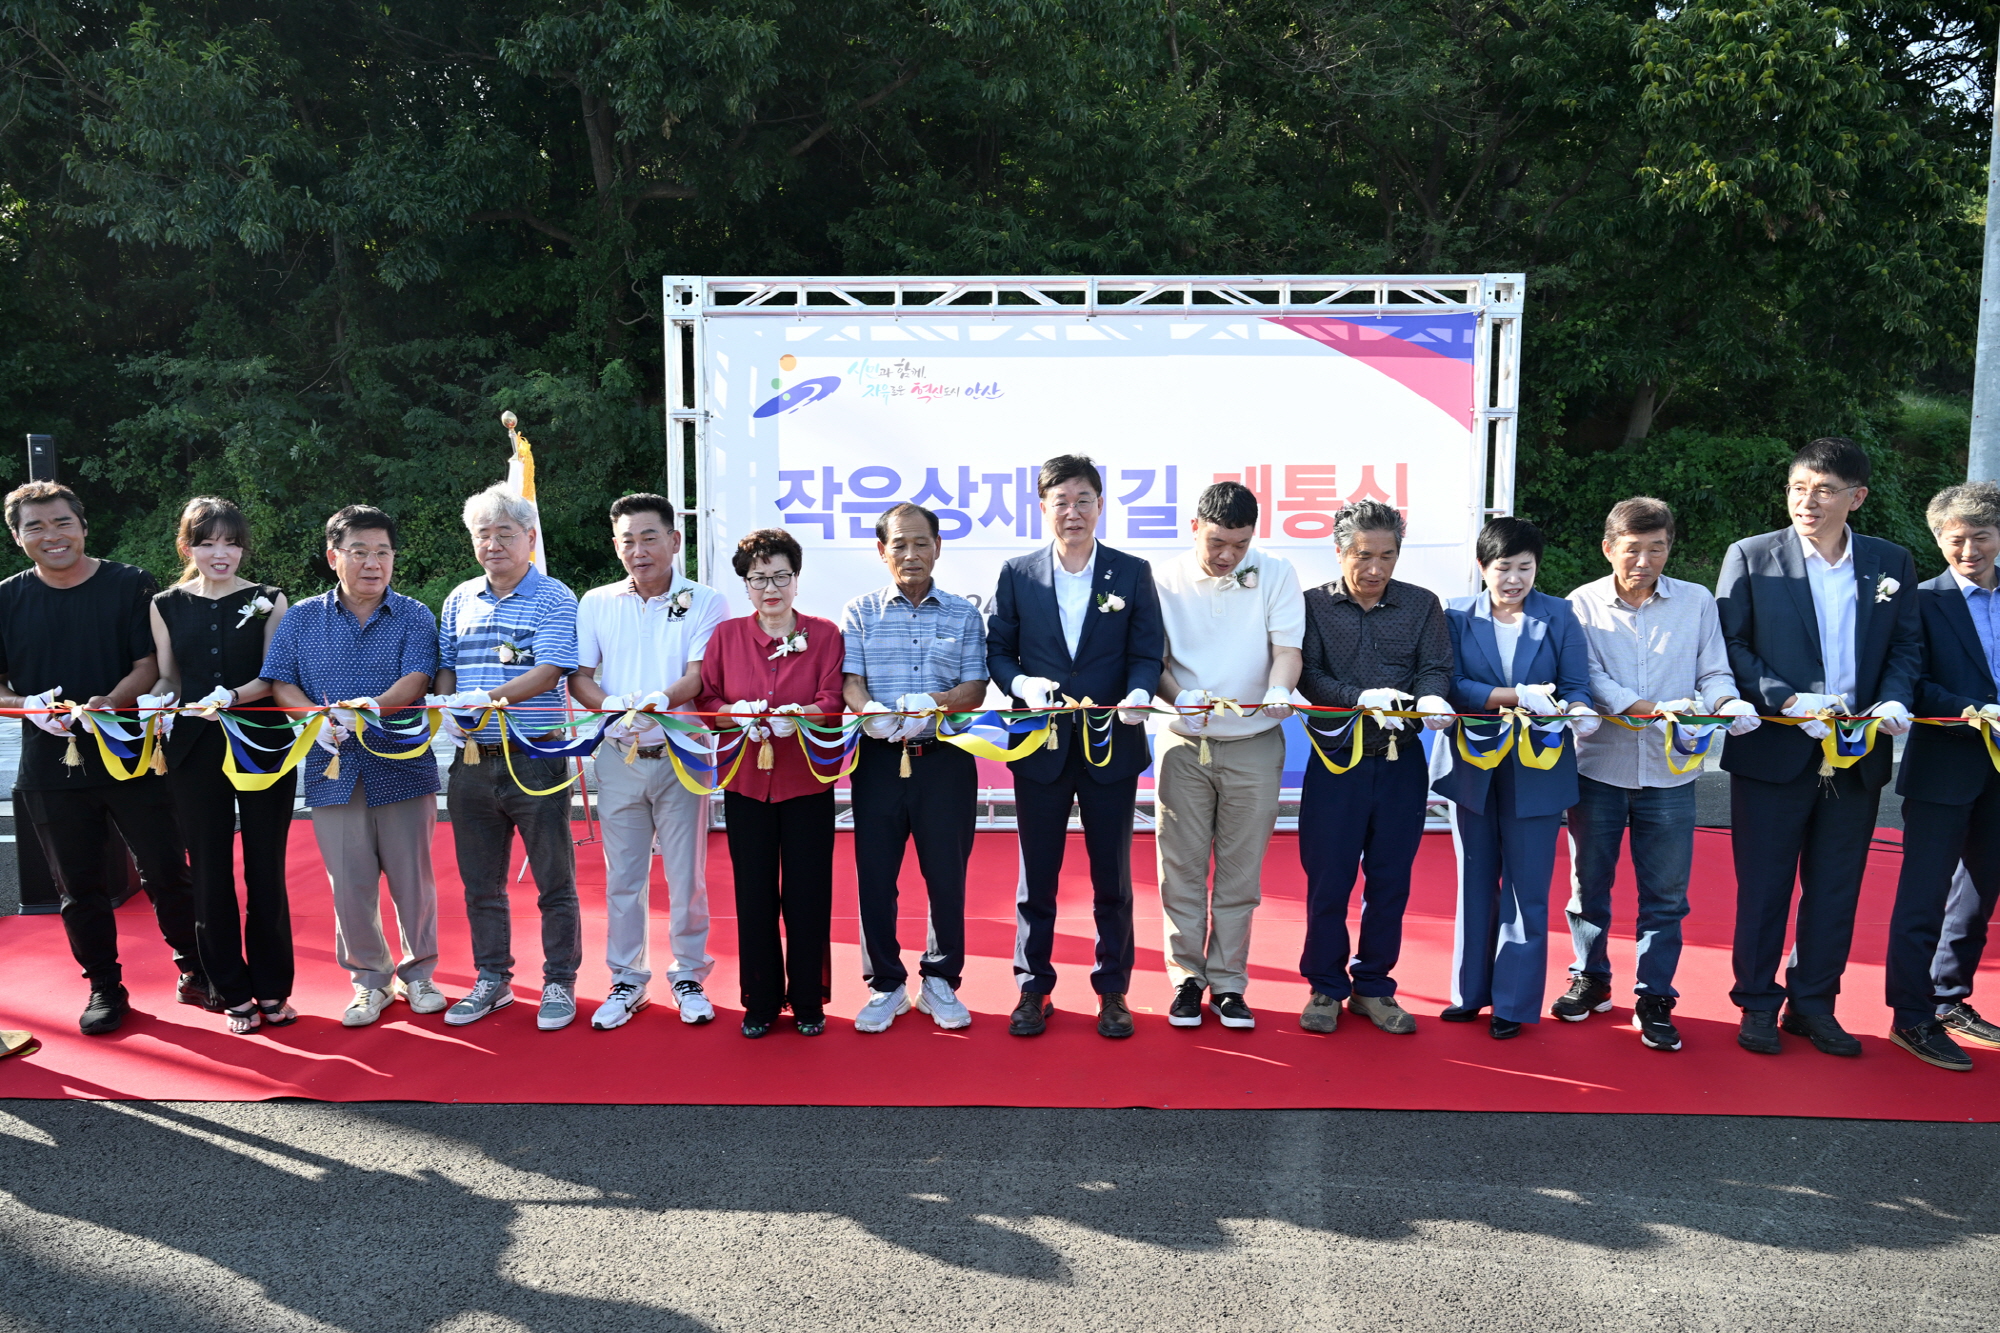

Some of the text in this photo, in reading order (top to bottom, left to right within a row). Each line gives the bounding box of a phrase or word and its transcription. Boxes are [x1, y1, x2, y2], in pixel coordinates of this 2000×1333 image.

[847, 358, 893, 385] 시민과
[862, 382, 1005, 406] 자유로운 혁신도시 안산
